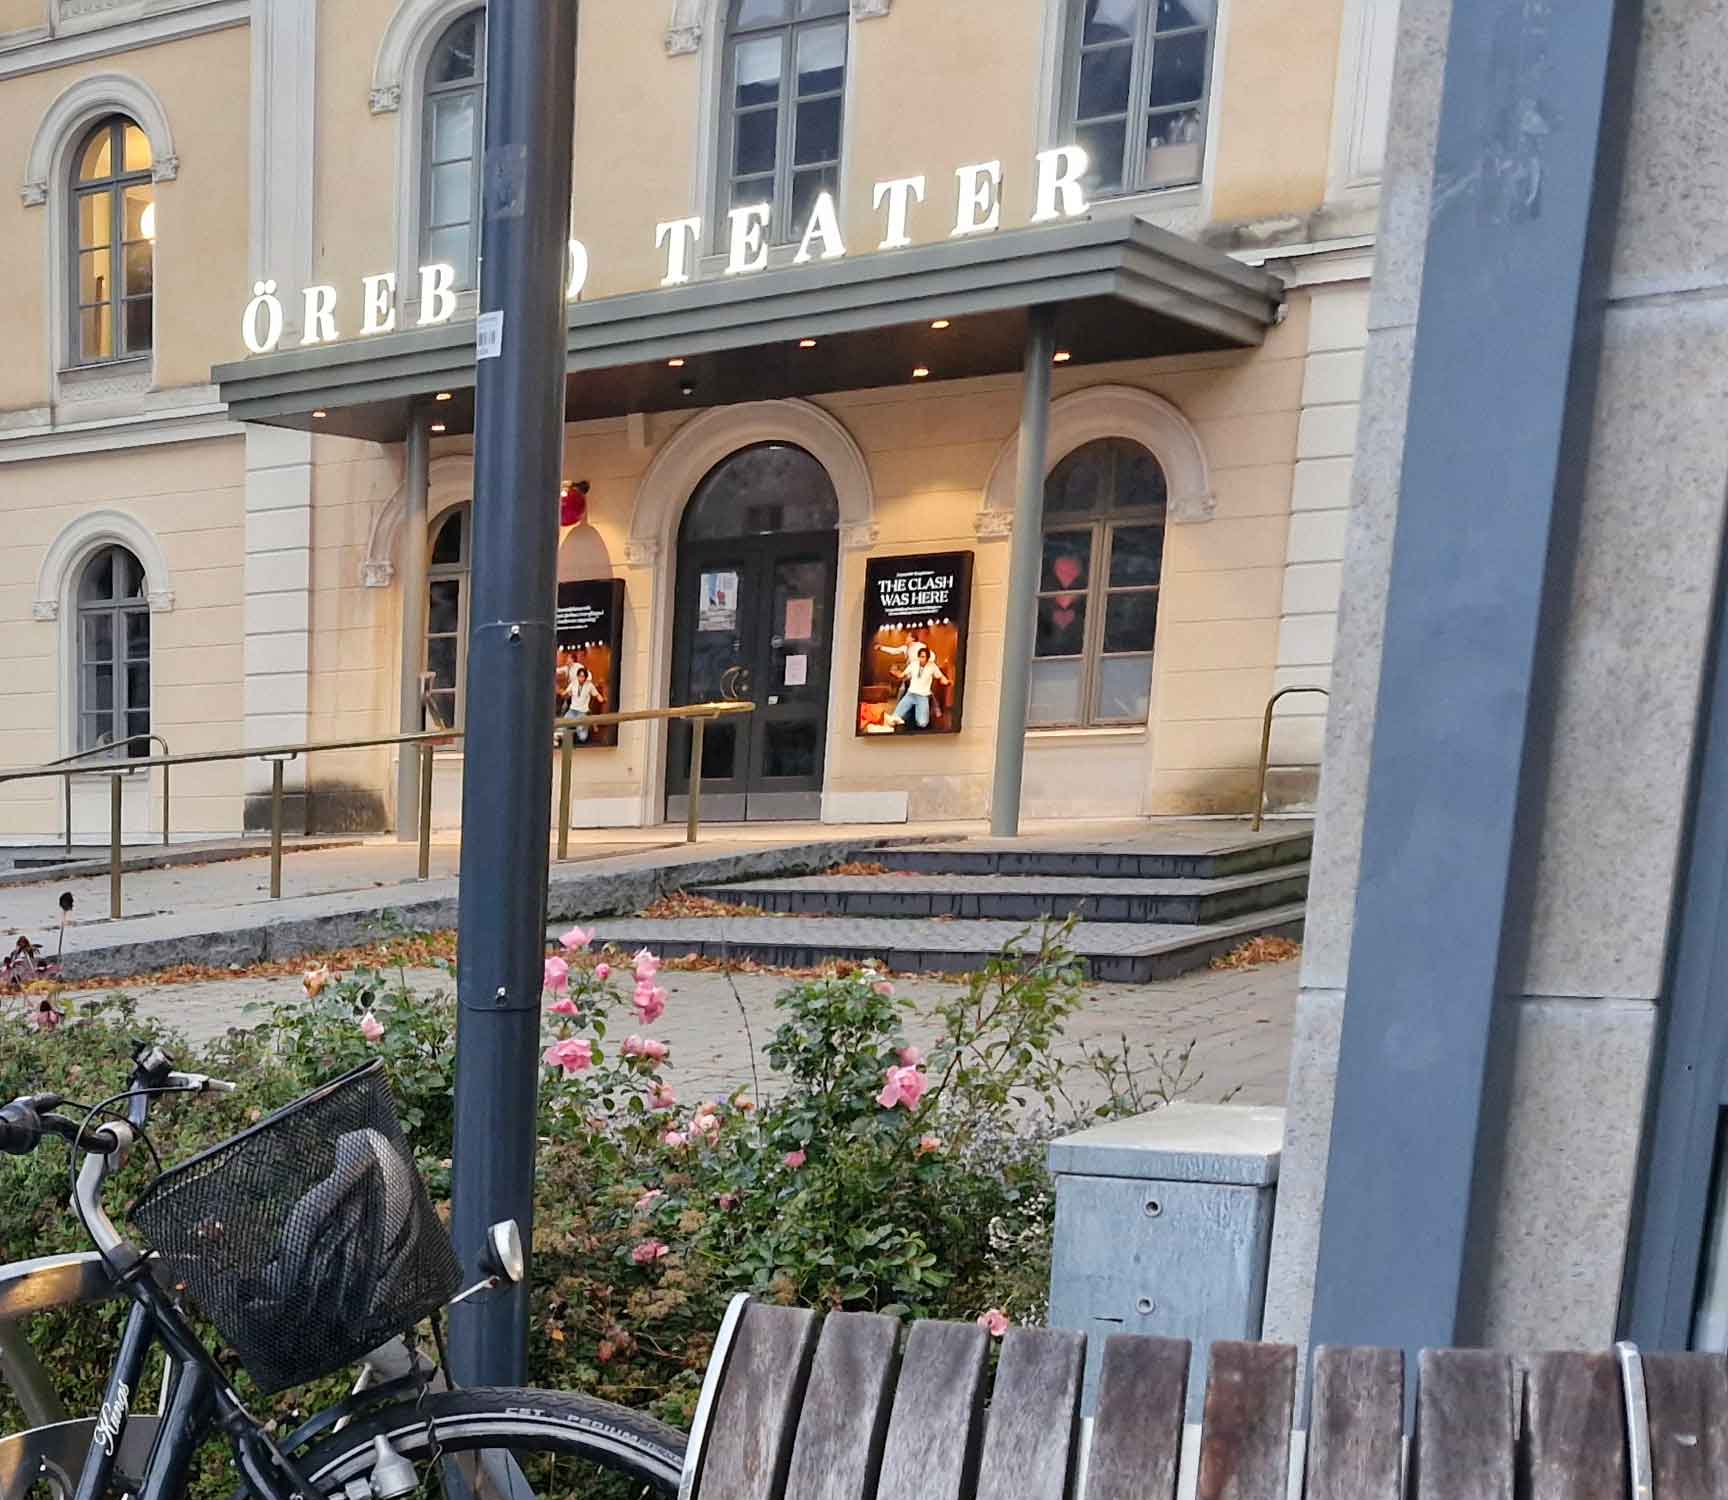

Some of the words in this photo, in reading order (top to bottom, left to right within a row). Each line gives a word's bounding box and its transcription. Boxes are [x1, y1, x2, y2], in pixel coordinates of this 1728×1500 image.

[241, 239, 588, 354] ÖREB
[655, 144, 1090, 287] TEATER
[878, 578, 907, 593] THE
[908, 575, 954, 591] CLASH
[880, 592, 909, 607] WAS
[911, 590, 949, 605] HERE
[505, 1406, 546, 1417] CST
[567, 1413, 641, 1446] PEDIUM
